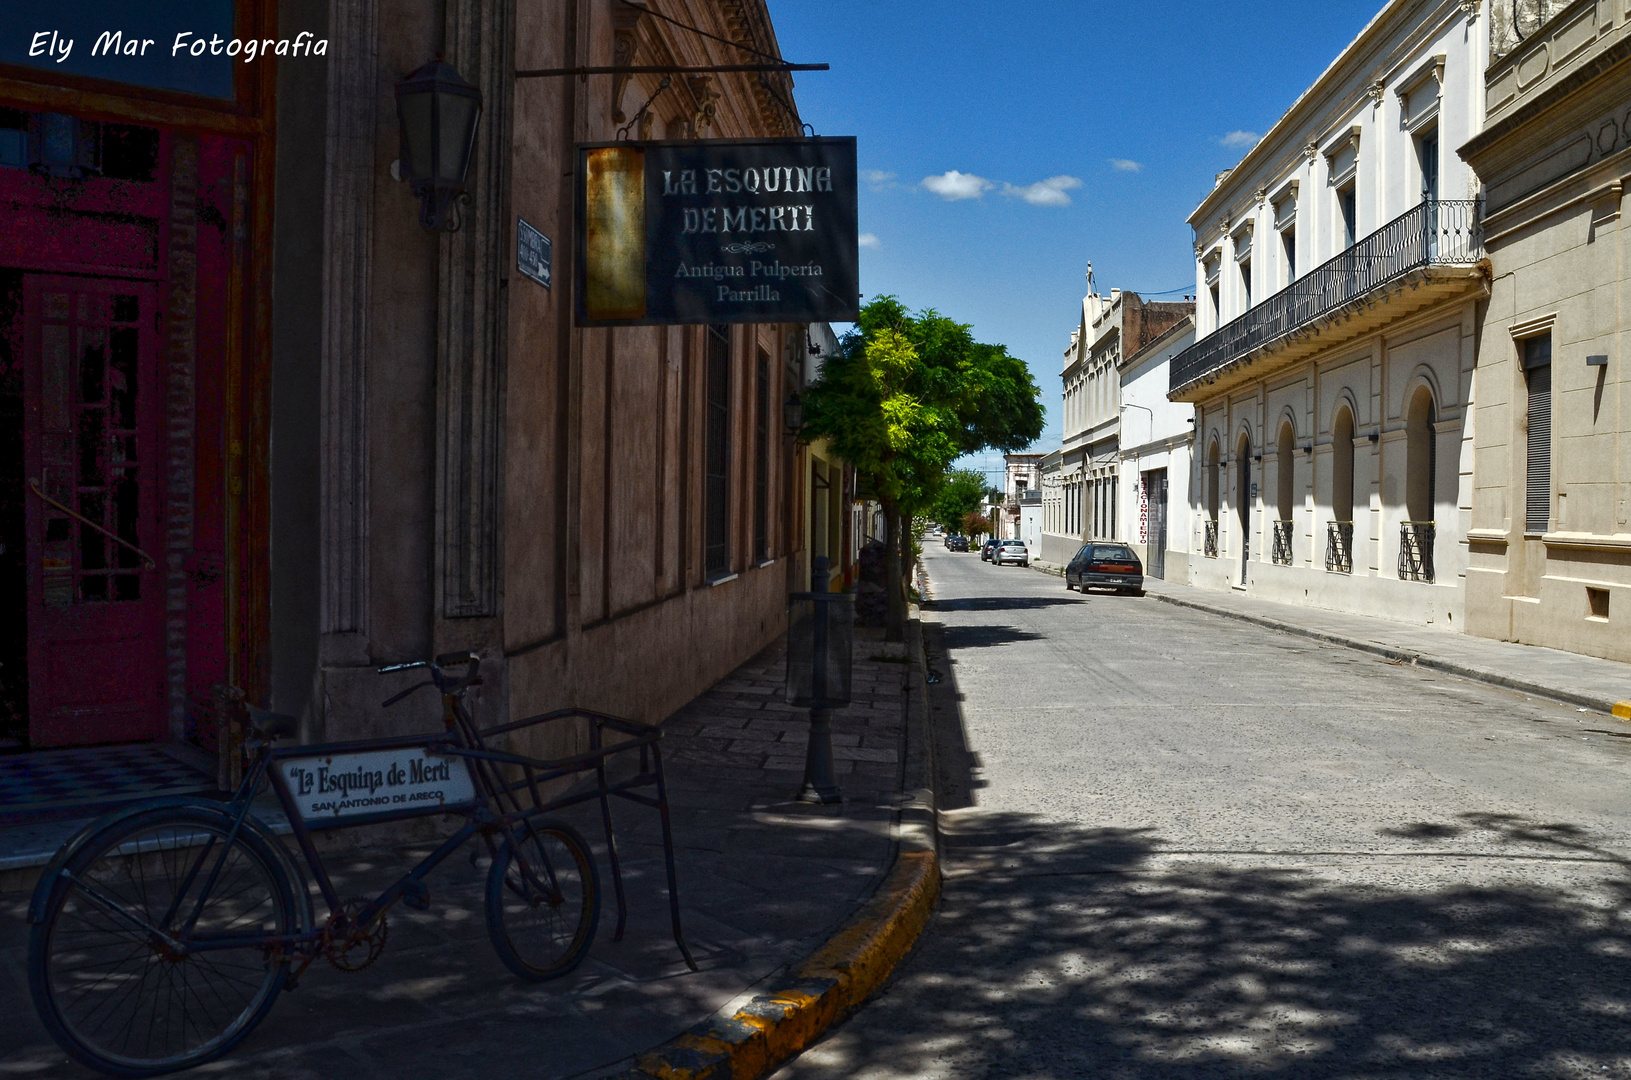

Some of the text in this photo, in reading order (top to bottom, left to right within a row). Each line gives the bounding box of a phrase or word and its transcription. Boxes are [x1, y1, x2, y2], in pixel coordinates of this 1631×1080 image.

[662, 166, 833, 196] LA ESQUINA
[682, 204, 815, 234] DE MERTI
[674, 260, 823, 281] Antigua Pulpería
[717, 285, 780, 302] Parrilla
[318, 764, 383, 798] Esquina
[387, 762, 406, 786] de
[312, 790, 444, 813] SAN ANTONIO DE ARECO
